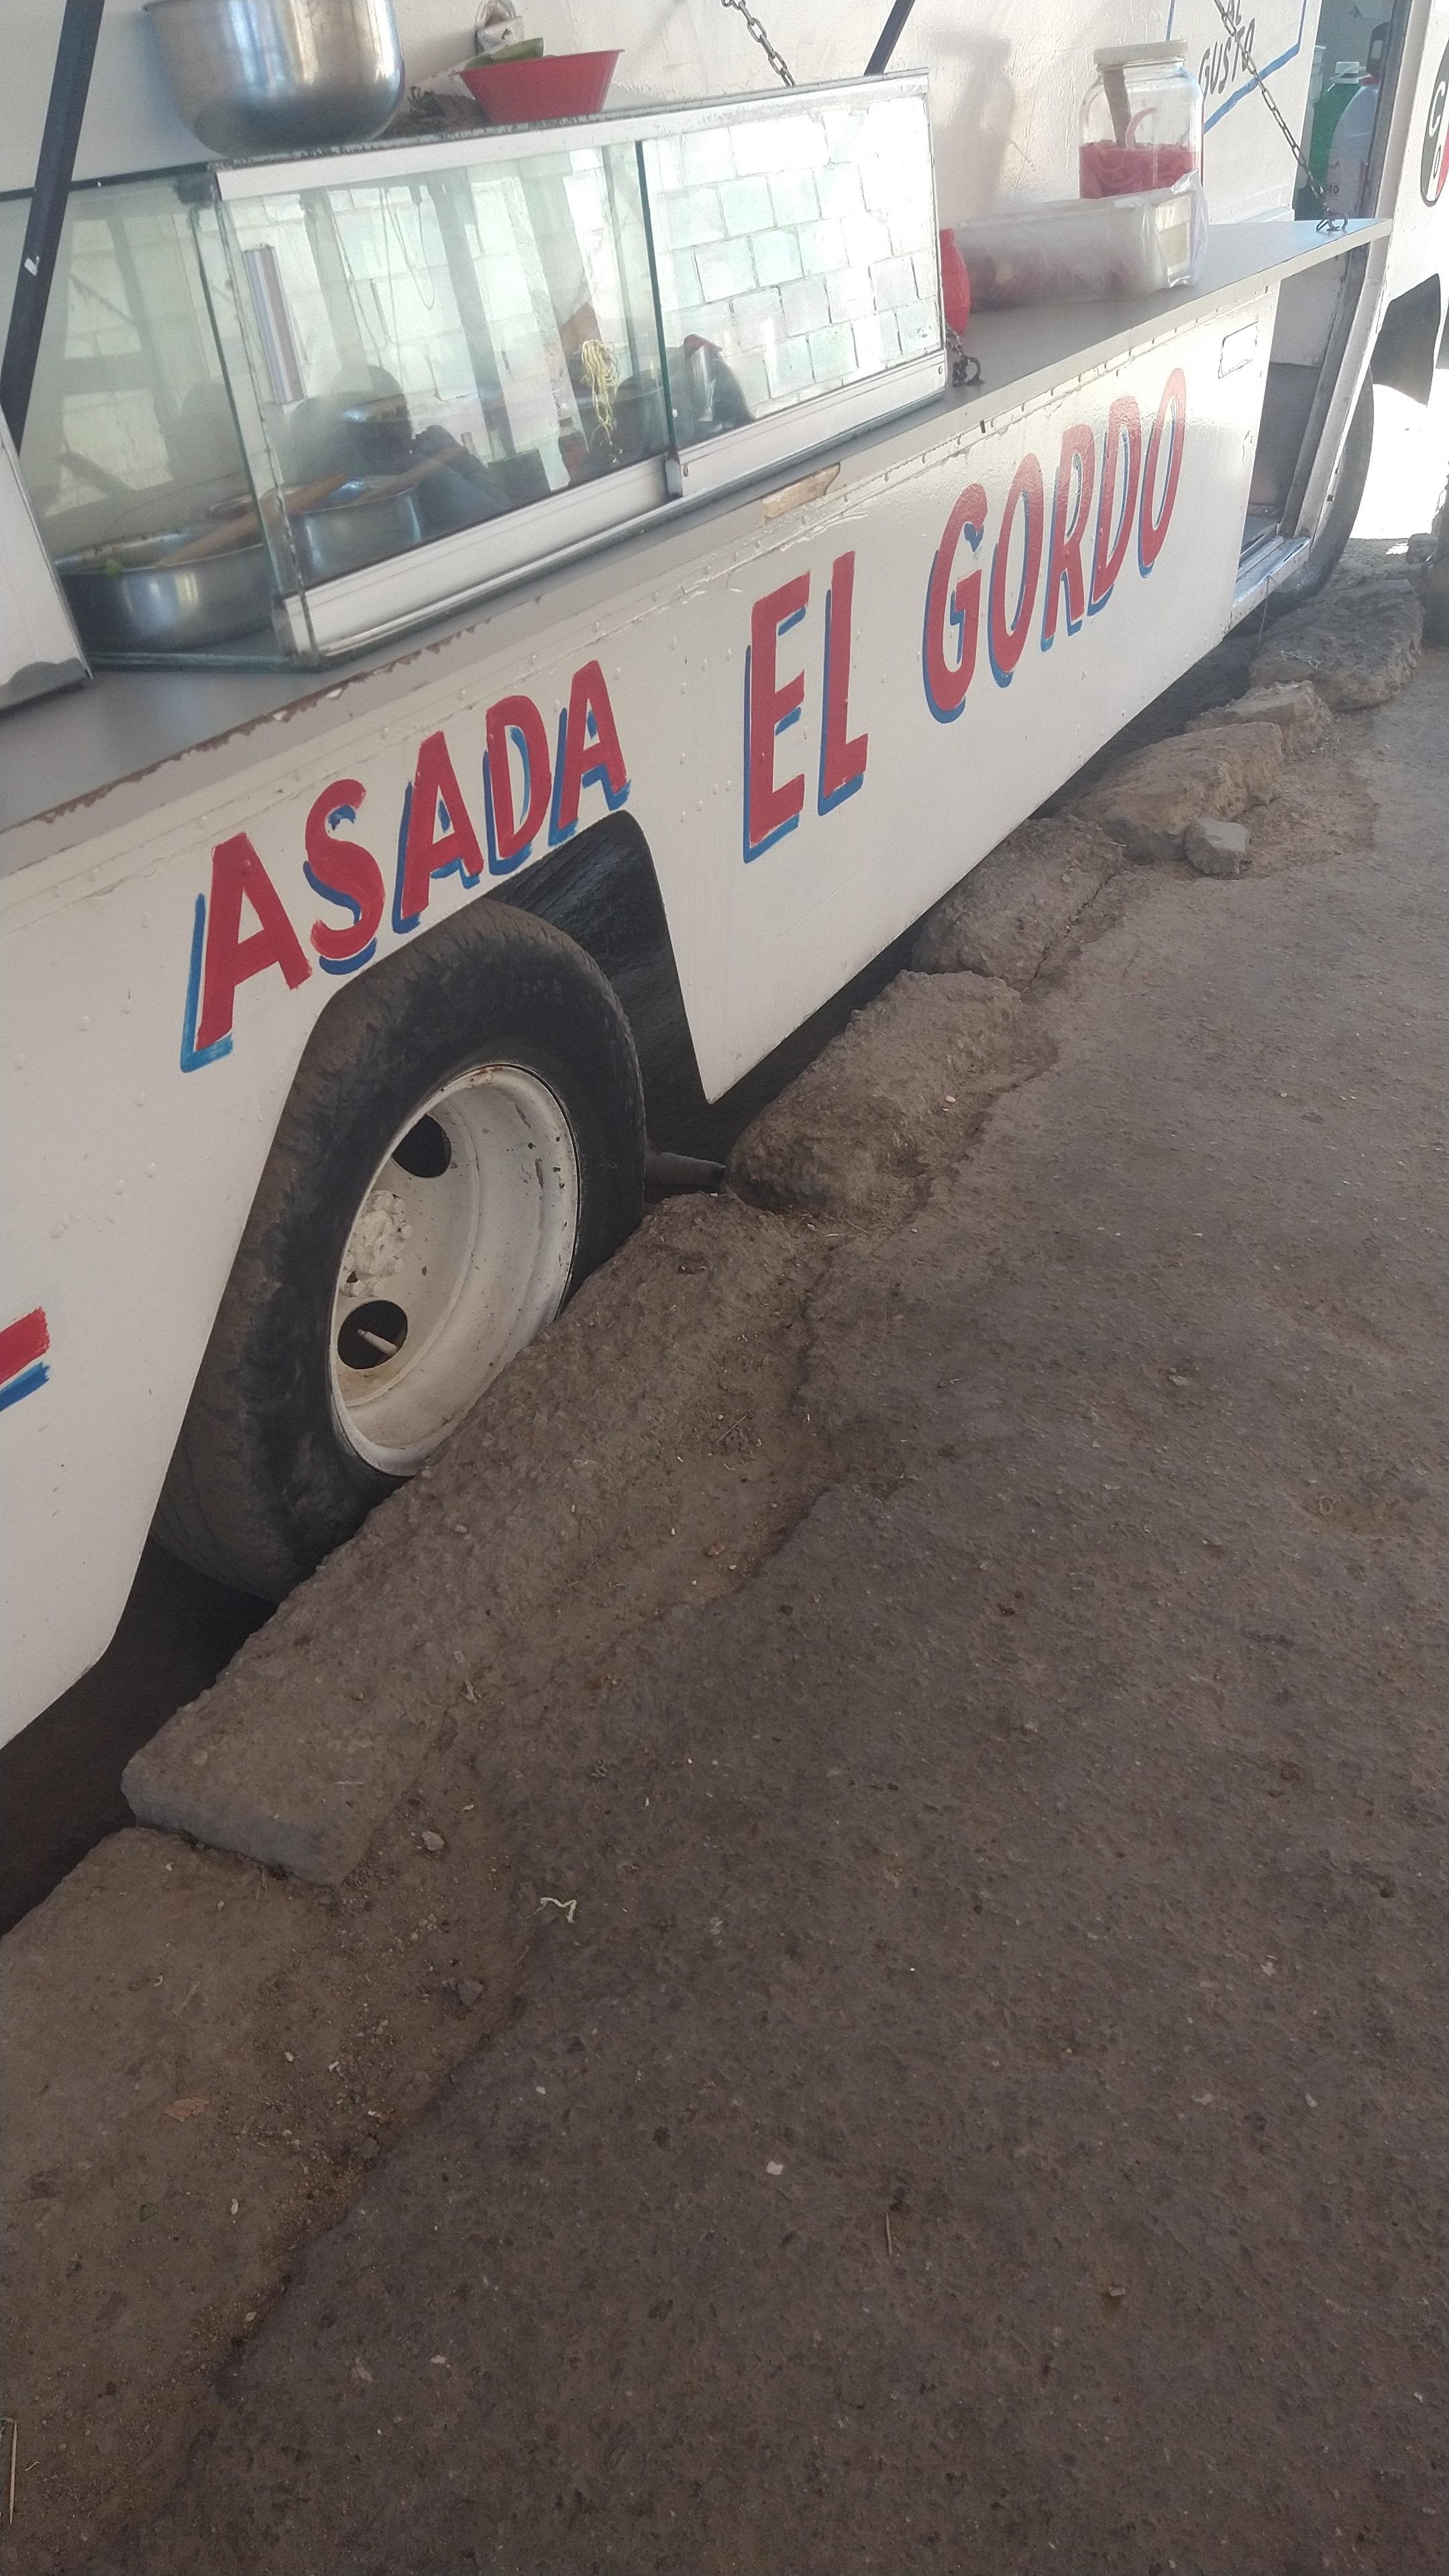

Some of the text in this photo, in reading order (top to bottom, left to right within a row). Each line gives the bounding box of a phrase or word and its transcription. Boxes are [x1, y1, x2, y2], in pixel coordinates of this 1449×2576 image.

[1198, 17, 1256, 97] GUSTO
[180, 368, 1186, 1073] ASADA EL GORDO
